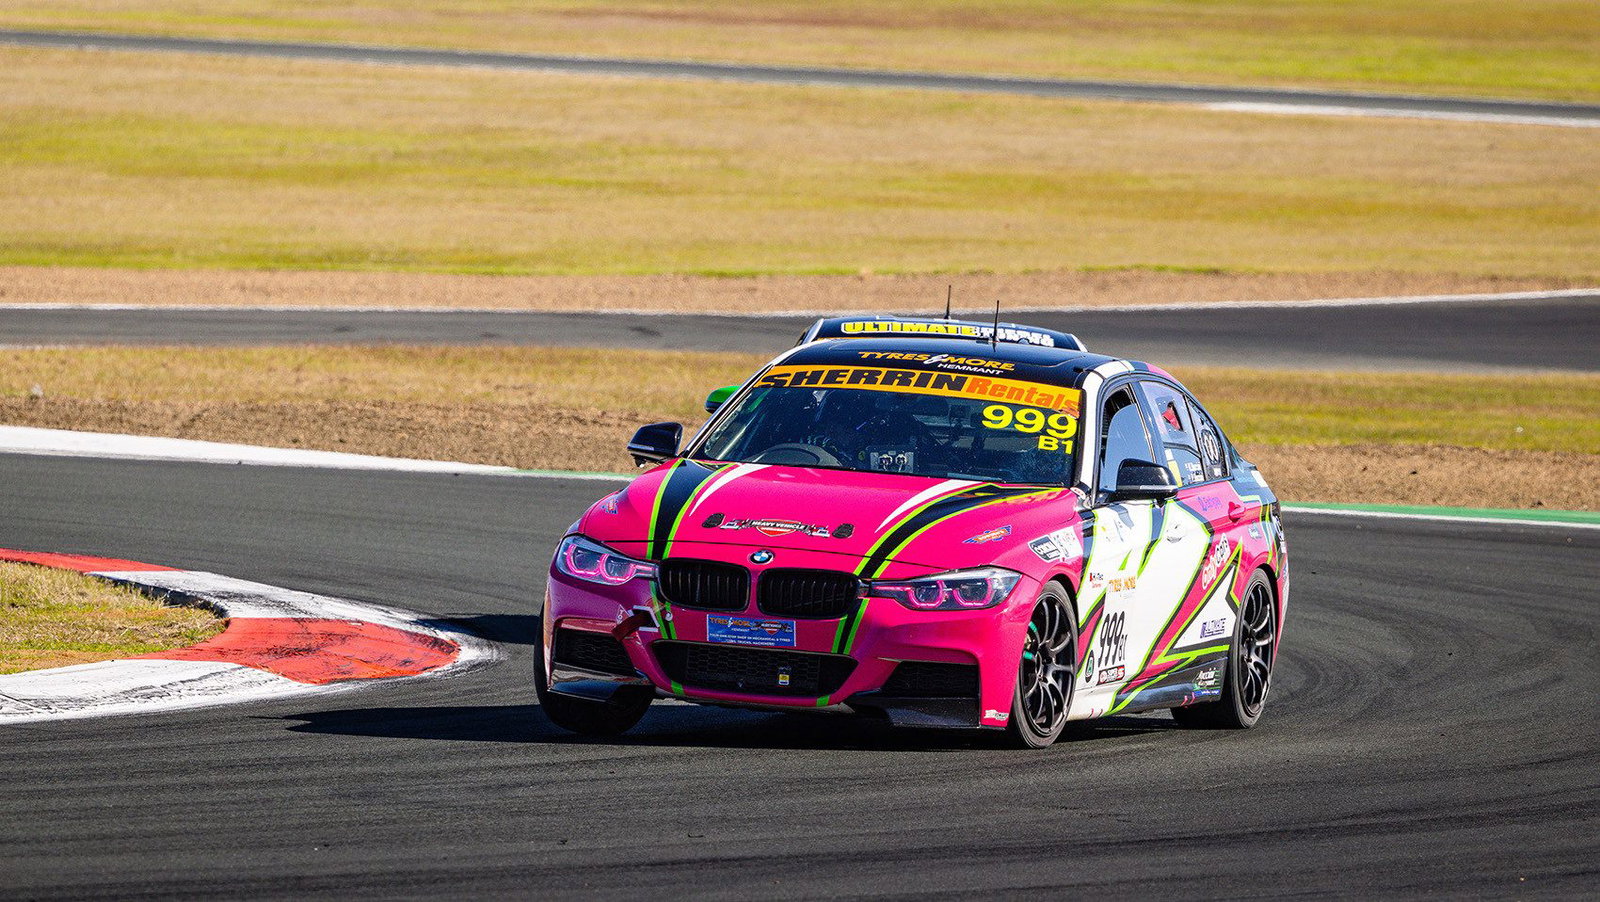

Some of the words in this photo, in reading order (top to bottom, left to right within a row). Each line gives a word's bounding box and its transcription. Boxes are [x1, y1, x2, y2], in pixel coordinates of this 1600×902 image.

[841, 322, 978, 336] ULTIMATE
[938, 363, 1003, 375] HEMMANT
[758, 369, 968, 392] SHERRIN
[966, 377, 1080, 418] Rentals
[982, 405, 1077, 439] 999
[1038, 436, 1073, 454] B1
[752, 520, 775, 528] HEAVY
[775, 522, 806, 530] VEHICLE
[1098, 611, 1125, 667] 999
